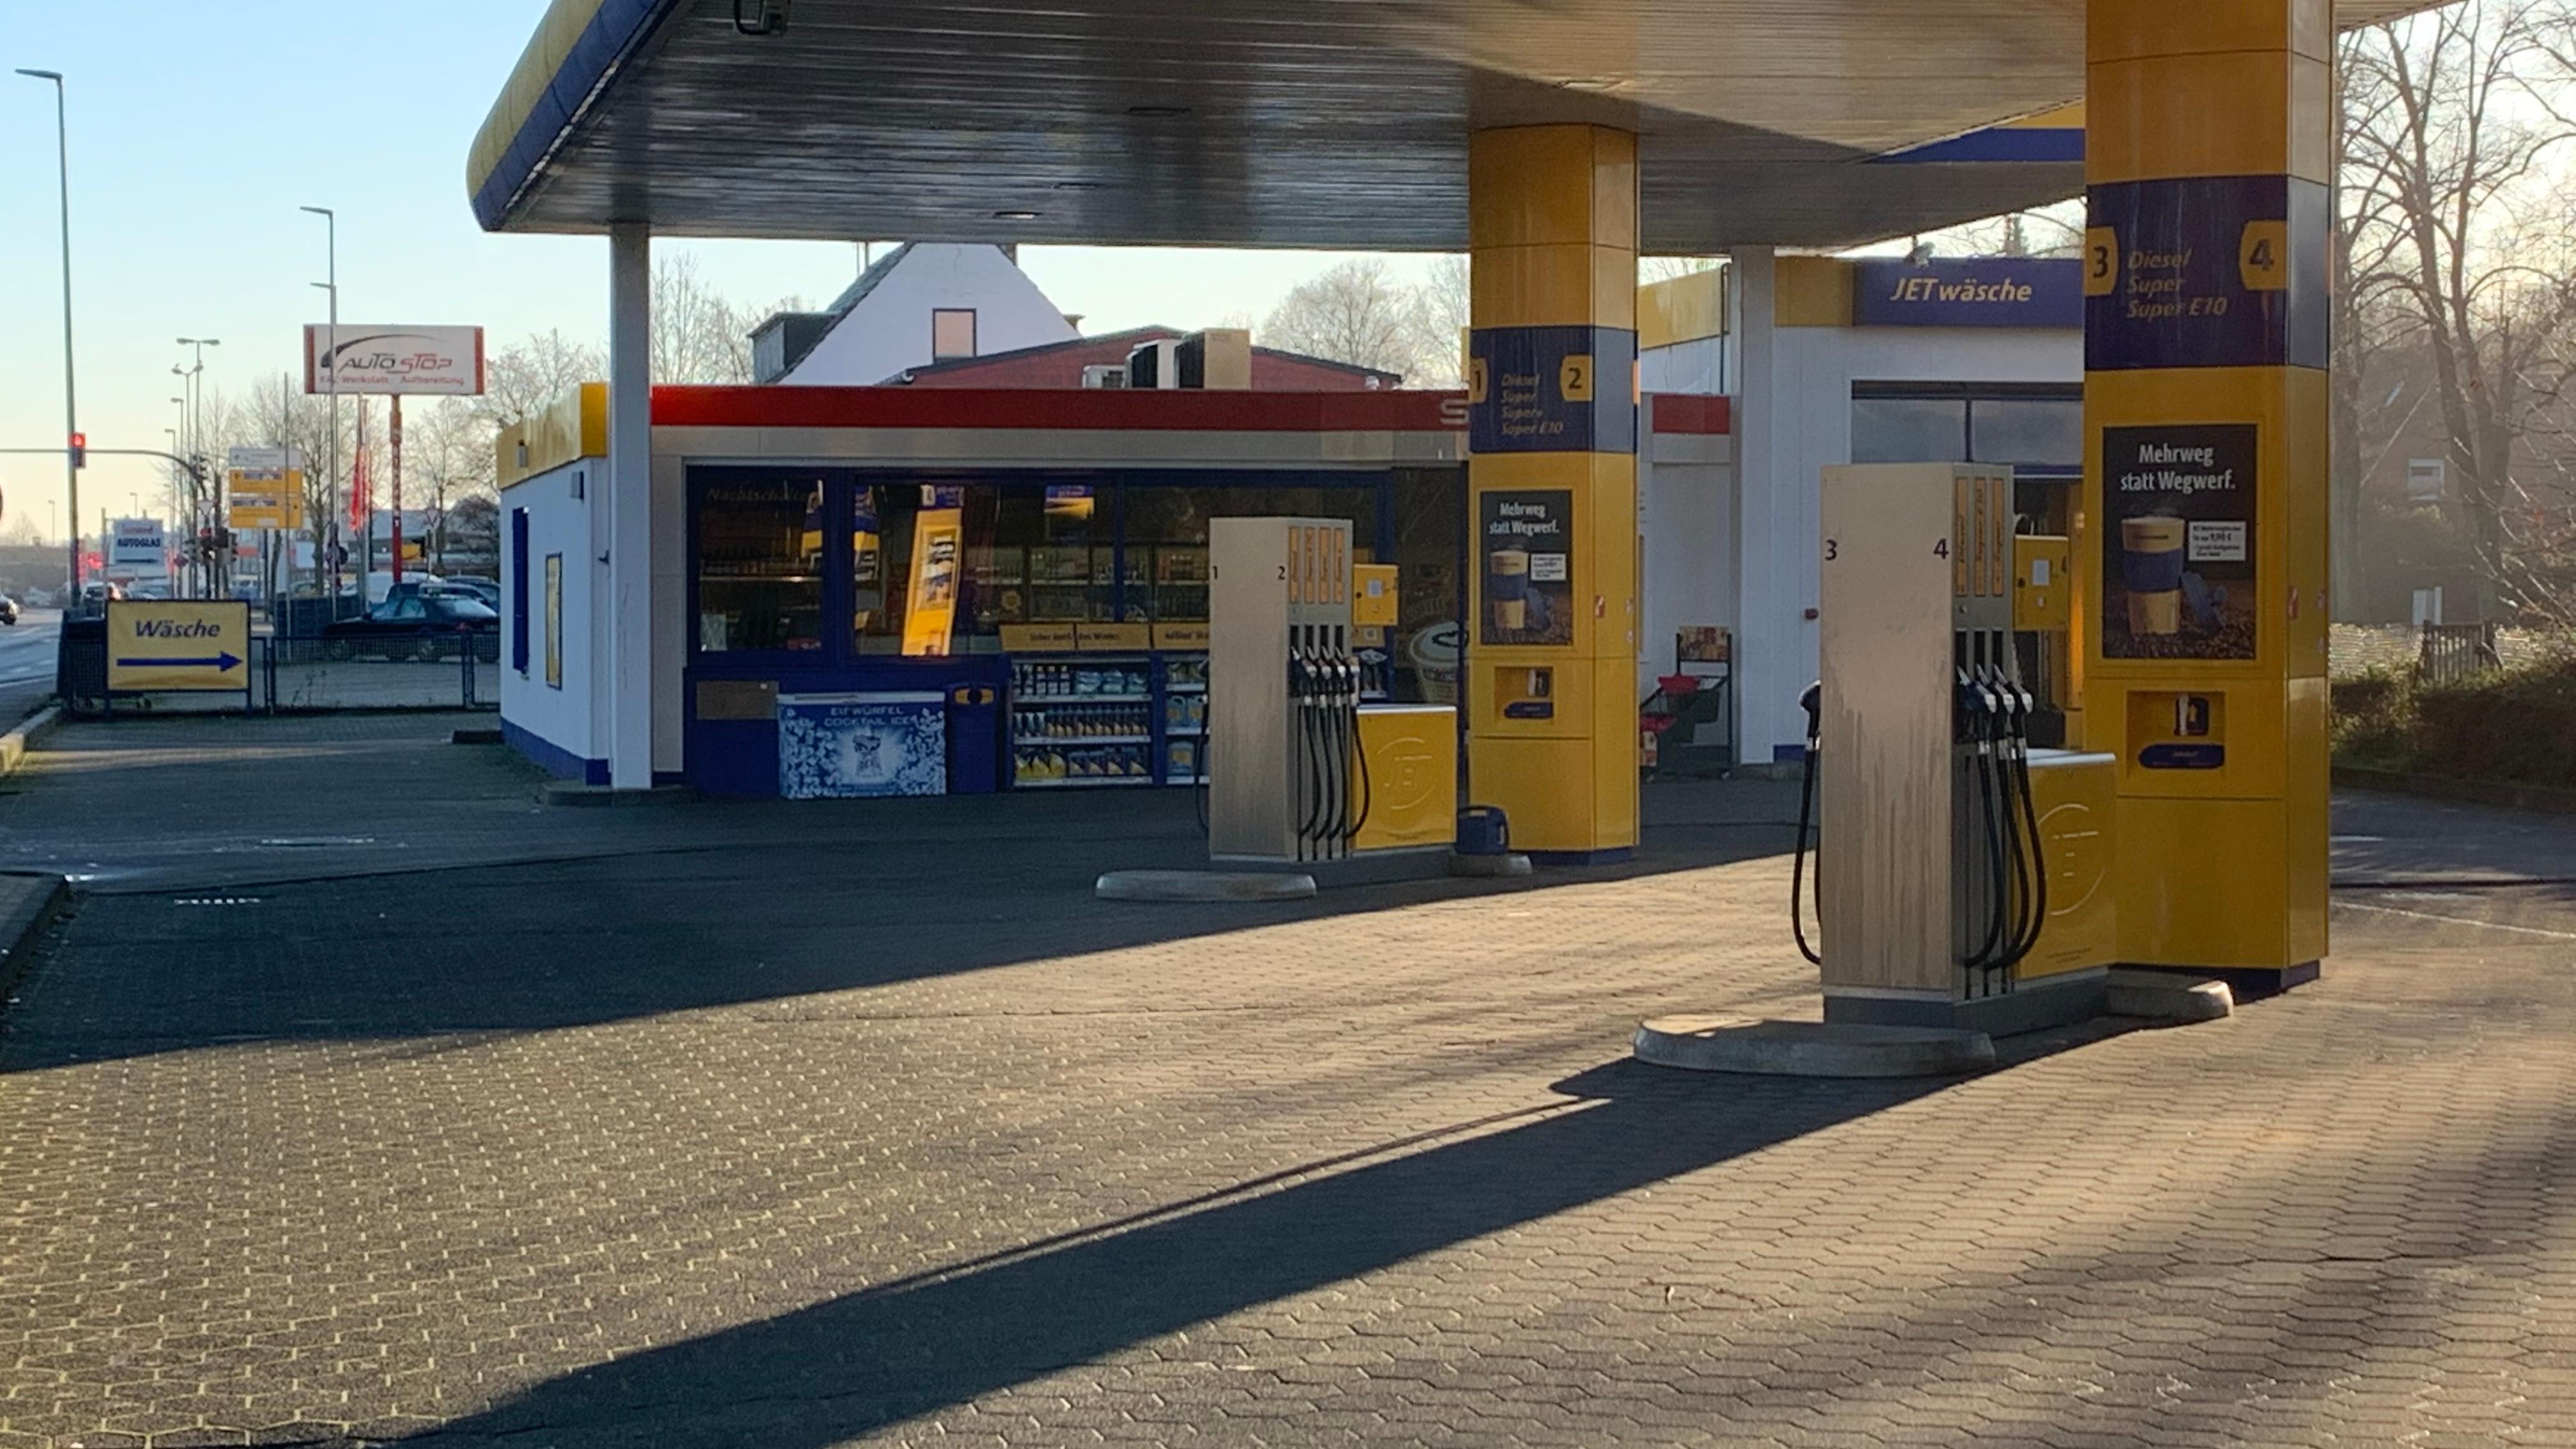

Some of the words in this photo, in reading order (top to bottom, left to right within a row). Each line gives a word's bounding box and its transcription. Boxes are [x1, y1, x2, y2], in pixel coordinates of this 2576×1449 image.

[2093, 245, 2109, 279] 3
[2127, 247, 2193, 270] Diesel
[2249, 238, 2275, 272] 4
[2126, 275, 2188, 300] Super
[2125, 298, 2182, 323] Super
[2188, 296, 2228, 316] E10
[1474, 370, 1482, 392] 1
[1568, 367, 1583, 390] 2
[1501, 390, 1537, 405] Super
[1501, 424, 1537, 438] Super
[1538, 422, 1564, 434] E10
[2138, 443, 2214, 468] Mehrweg
[2120, 471, 2155, 491] statt
[2157, 468, 2236, 495] Wegwerf.
[1499, 502, 1546, 519] Mehrweg
[1489, 521, 1510, 535] statt
[1512, 519, 1560, 537] Wegwerf.
[117, 538, 161, 548] AUTOGLAS
[1825, 539, 1837, 561] 3
[1933, 538, 1949, 560] 4
[1213, 565, 1218, 579] 1
[1278, 565, 1286, 580] 2
[135, 618, 221, 638] Wäsche
